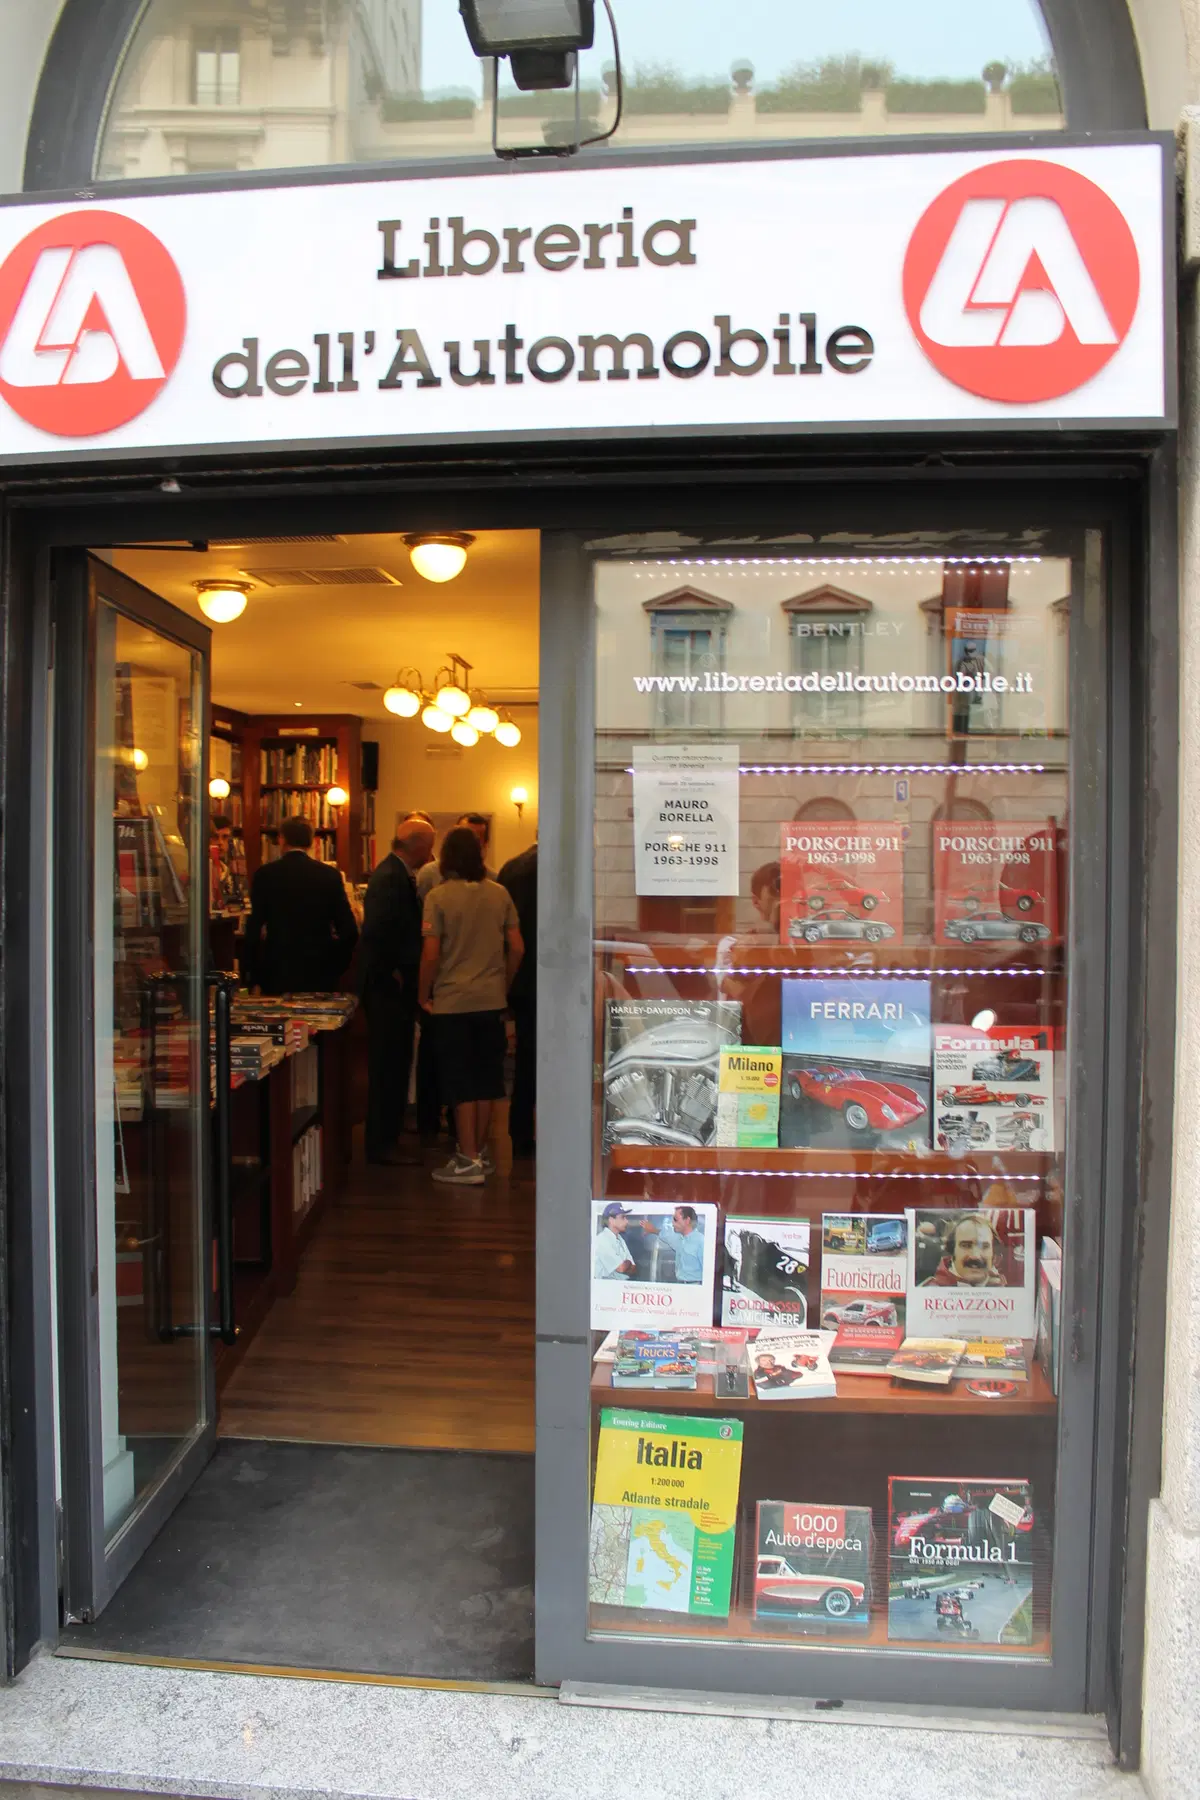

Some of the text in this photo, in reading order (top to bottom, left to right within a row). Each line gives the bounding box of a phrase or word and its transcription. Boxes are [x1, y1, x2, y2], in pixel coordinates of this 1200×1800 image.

[377, 206, 697, 280] Libreria
[212, 312, 874, 399] dell’Automobile
[797, 621, 904, 637] BENTLEY
[633, 670, 1034, 694] www.libreriadellautomobile.it
[664, 800, 709, 809] MAURO
[659, 813, 714, 822] BORELLA
[645, 842, 727, 853] PORSCHE 911
[786, 836, 900, 851] PORSCHE 911
[939, 836, 1054, 851] PORSCHE 911
[653, 856, 719, 866] 1963-1998
[807, 852, 876, 864] 1963-1998
[961, 852, 1030, 864] 1963-1998
[611, 1006, 691, 1015] HARLEY-DAVIDSON
[810, 1002, 904, 1020] FERRARI
[936, 1035, 1035, 1050] Formula
[728, 1057, 773, 1071] Milano
[776, 1256, 799, 1275] 28
[827, 1267, 902, 1290] Fuoristrada
[621, 1292, 673, 1306] FIORIO
[924, 1298, 1015, 1311] REGAZZONI
[773, 1313, 800, 1325] NERE
[638, 1347, 676, 1357] TRUCKS
[612, 1417, 667, 1430] Touring Editore
[636, 1438, 703, 1470] Italia
[622, 1491, 710, 1510] Atlante stradale
[792, 1514, 838, 1532] 1000
[765, 1529, 862, 1553] Auto d'epoca
[908, 1536, 1019, 1562] Formula 1
